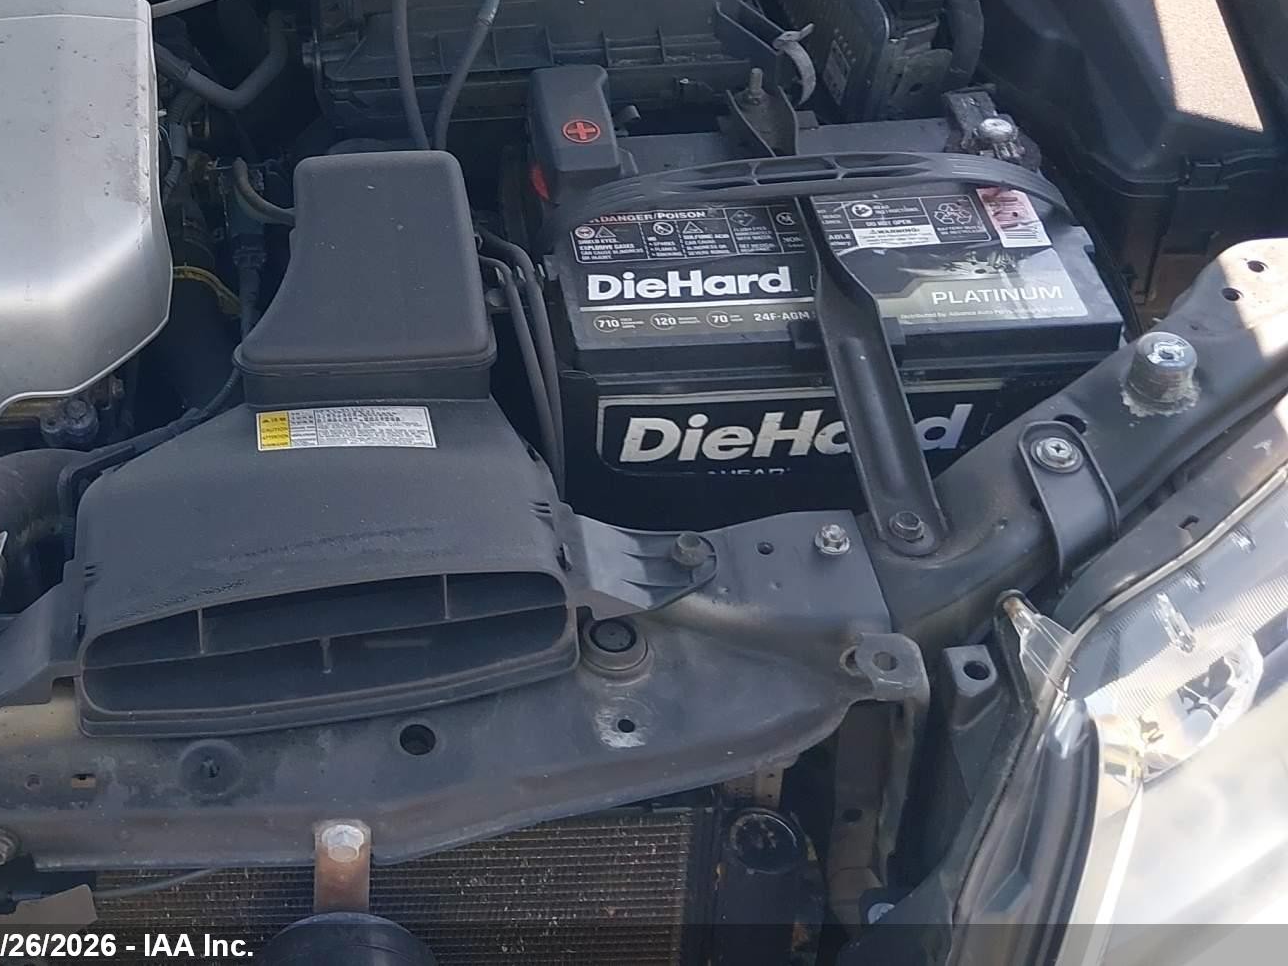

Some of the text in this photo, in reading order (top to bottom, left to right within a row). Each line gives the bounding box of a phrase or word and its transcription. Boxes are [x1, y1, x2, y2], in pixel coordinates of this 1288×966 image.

[599, 211, 707, 223] DANGER/POISON
[587, 265, 793, 301] DieHard
[931, 285, 1064, 305] PLATINUM
[598, 319, 620, 328] 710
[654, 317, 677, 326] 120
[712, 314, 729, 323] 70
[619, 403, 973, 463] DieHad
